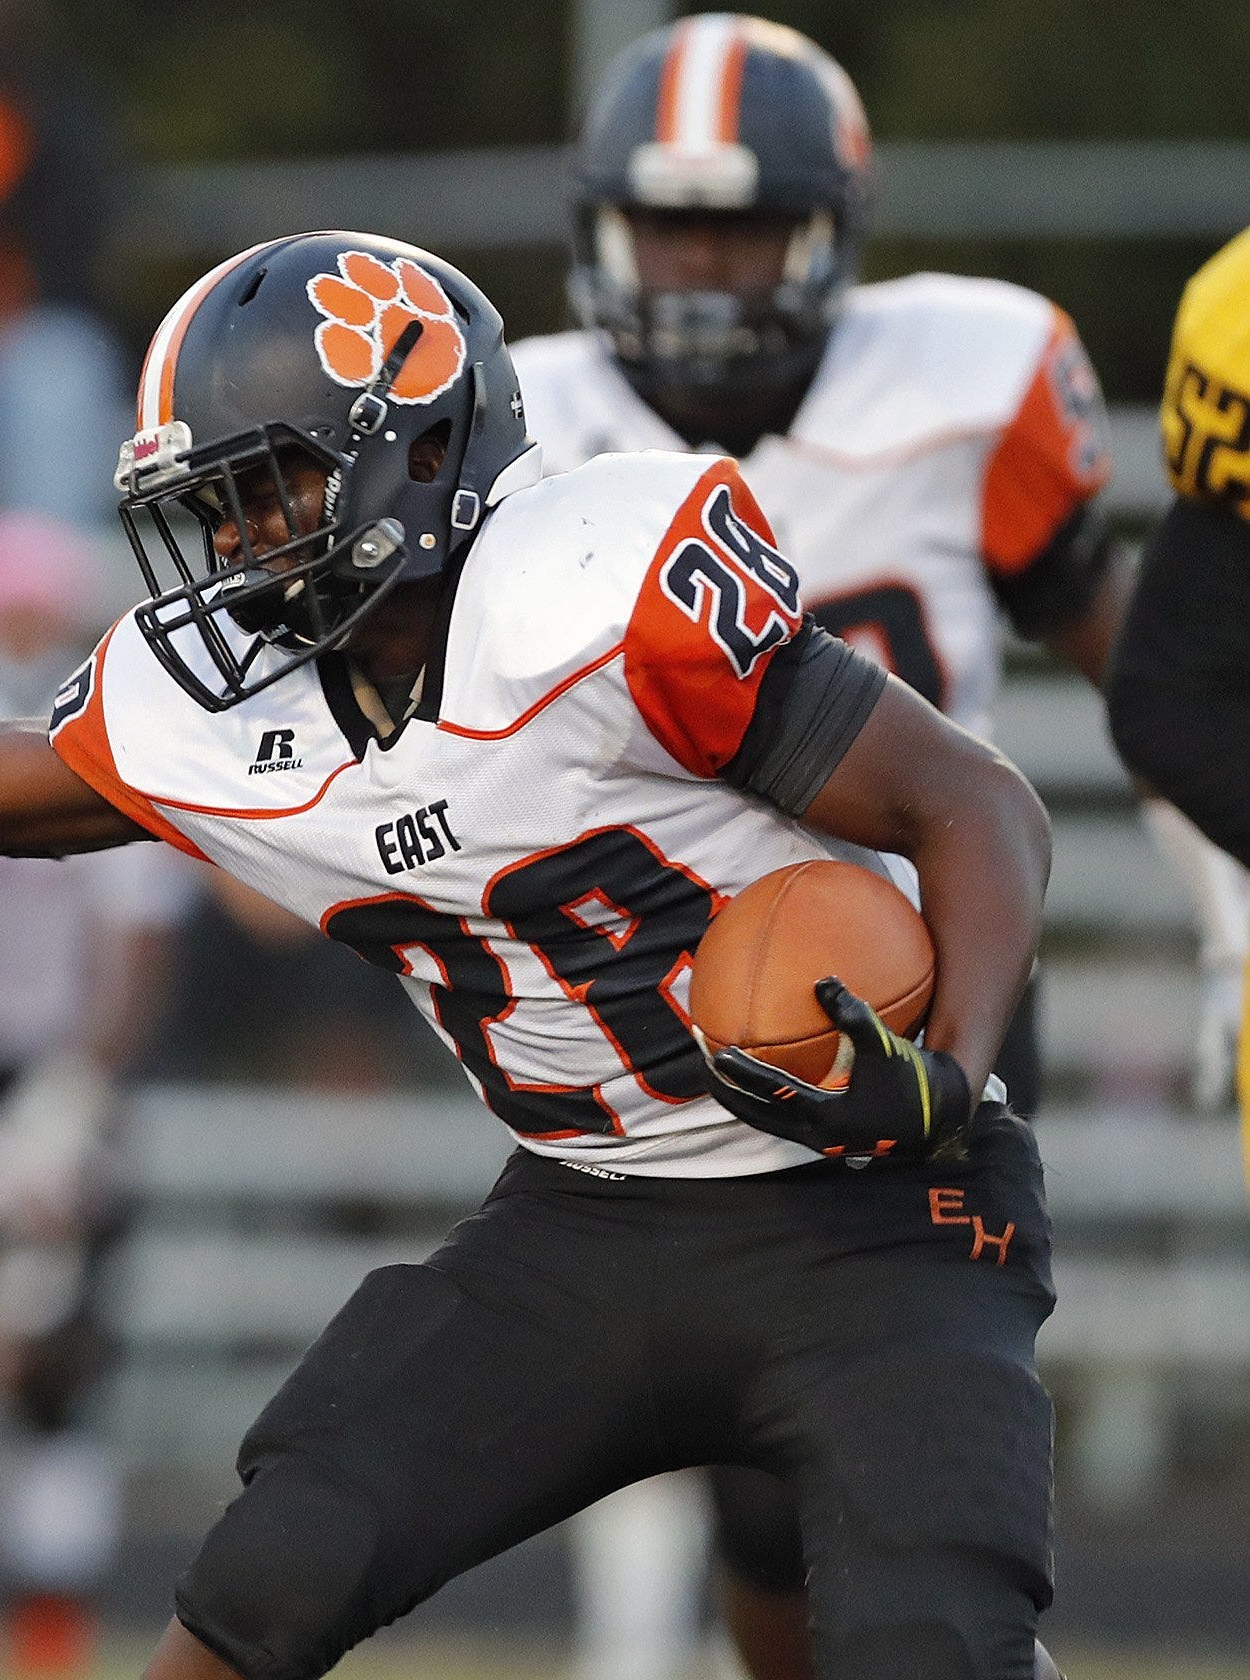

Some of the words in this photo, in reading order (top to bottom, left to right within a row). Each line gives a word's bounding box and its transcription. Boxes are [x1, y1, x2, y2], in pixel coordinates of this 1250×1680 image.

[658, 483, 802, 680] 28
[248, 758, 304, 776] RUSSELL
[375, 799, 461, 875] EAST
[319, 823, 730, 1141] 28
